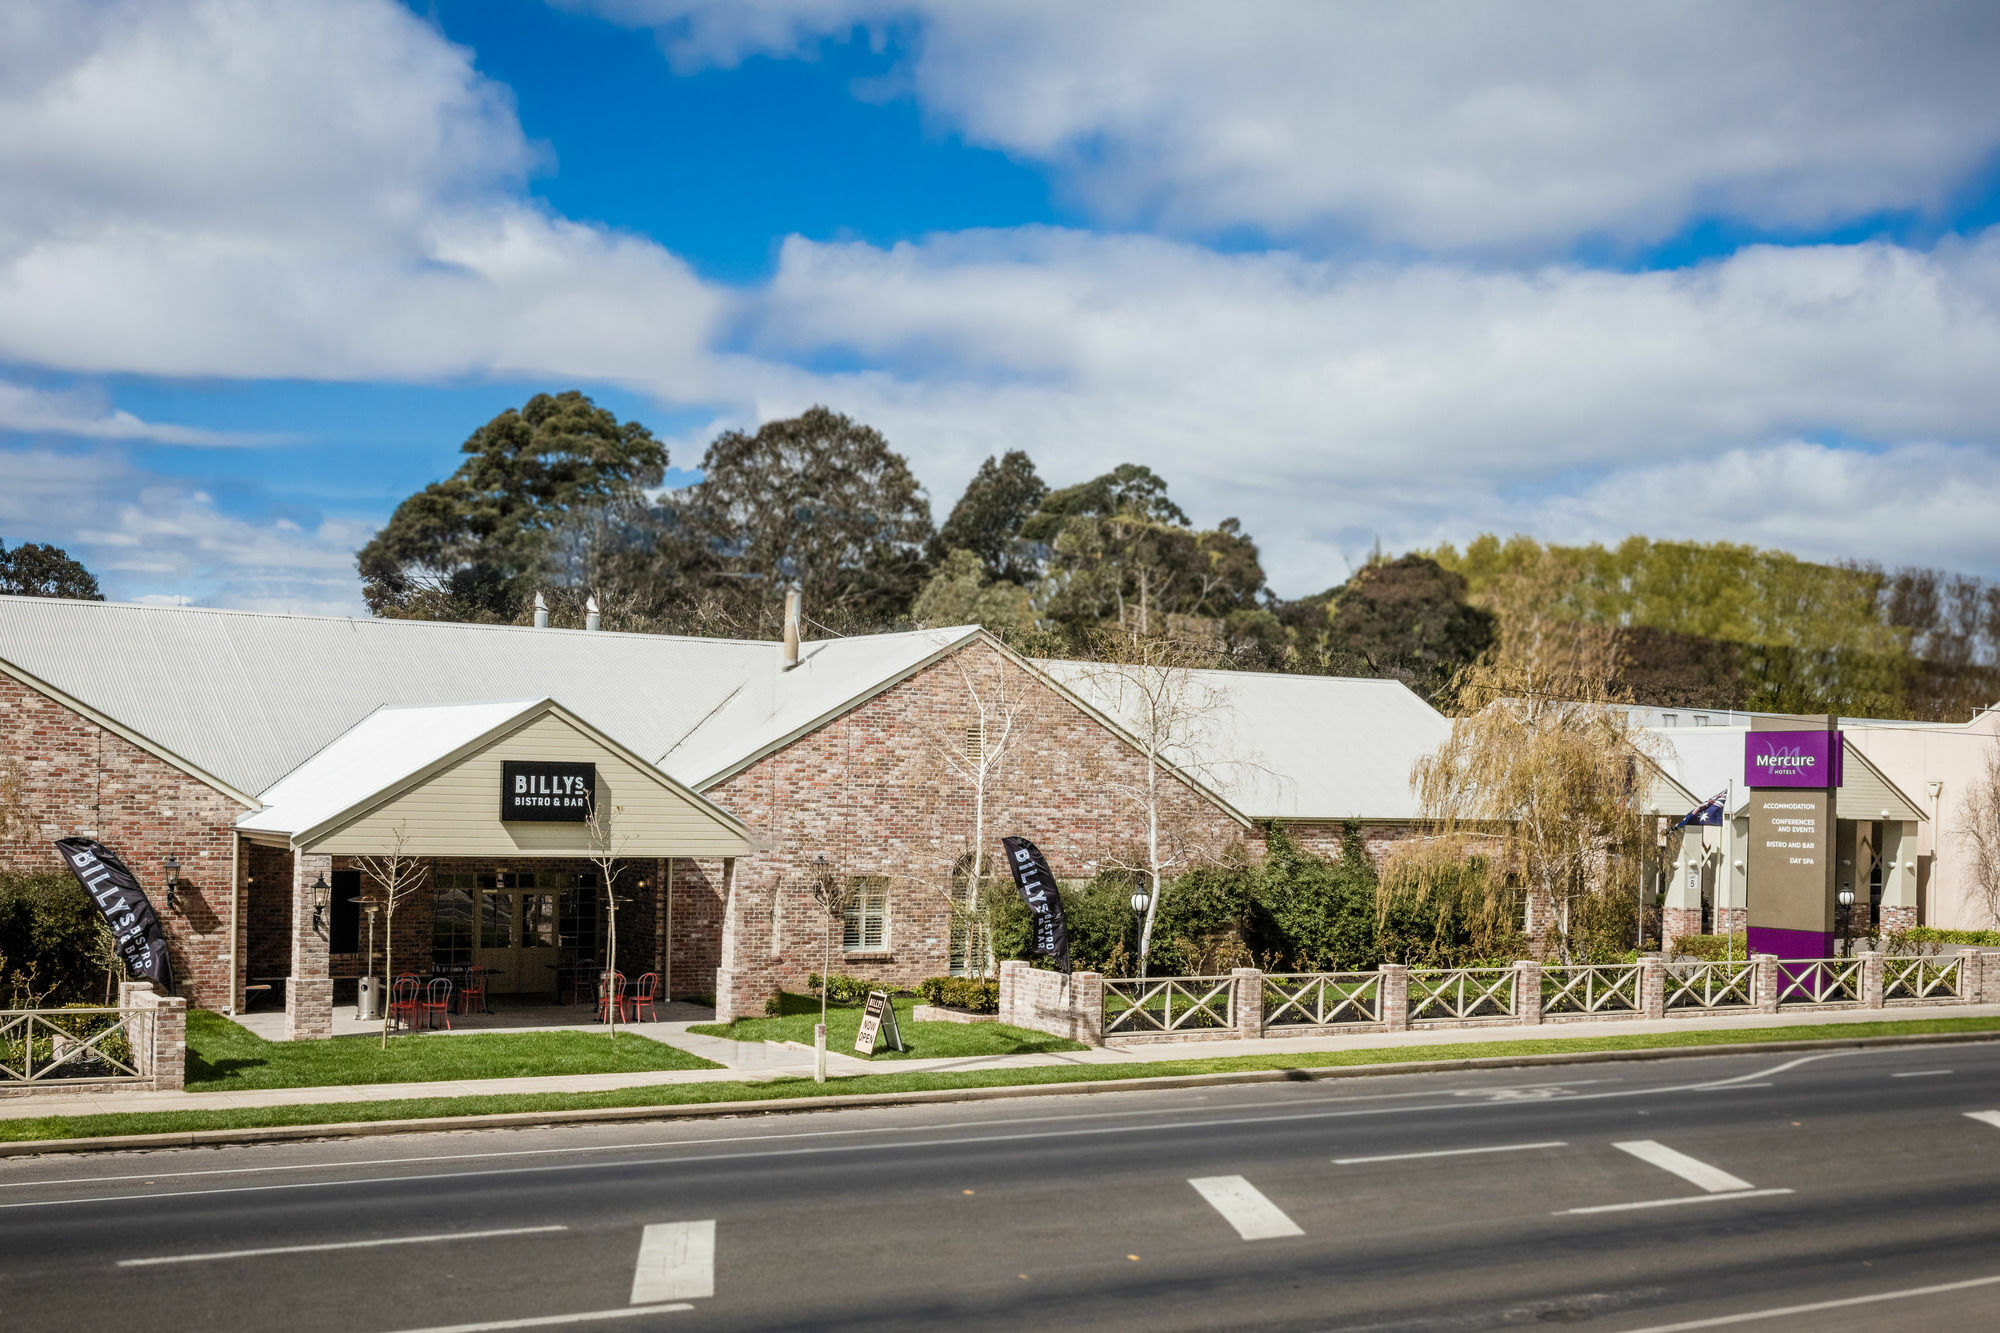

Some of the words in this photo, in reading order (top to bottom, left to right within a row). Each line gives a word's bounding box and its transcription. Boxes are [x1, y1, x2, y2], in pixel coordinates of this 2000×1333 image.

[1756, 755, 1815, 766] Mercure
[515, 775, 584, 795] BILLYS
[515, 797, 551, 806] BISTRO
[553, 798, 561, 806] &
[564, 797, 584, 807] BAR
[1763, 802, 1816, 810] ACCOMMODATION
[1771, 818, 1815, 826] CONFERENCES
[1014, 848, 1049, 913] BILLYS
[71, 849, 136, 931] BILLYS
[130, 925, 153, 969] BISTRO
[125, 946, 143, 970] BAR
[864, 1020, 876, 1031] NOW
[858, 1032, 874, 1044] OPEN
